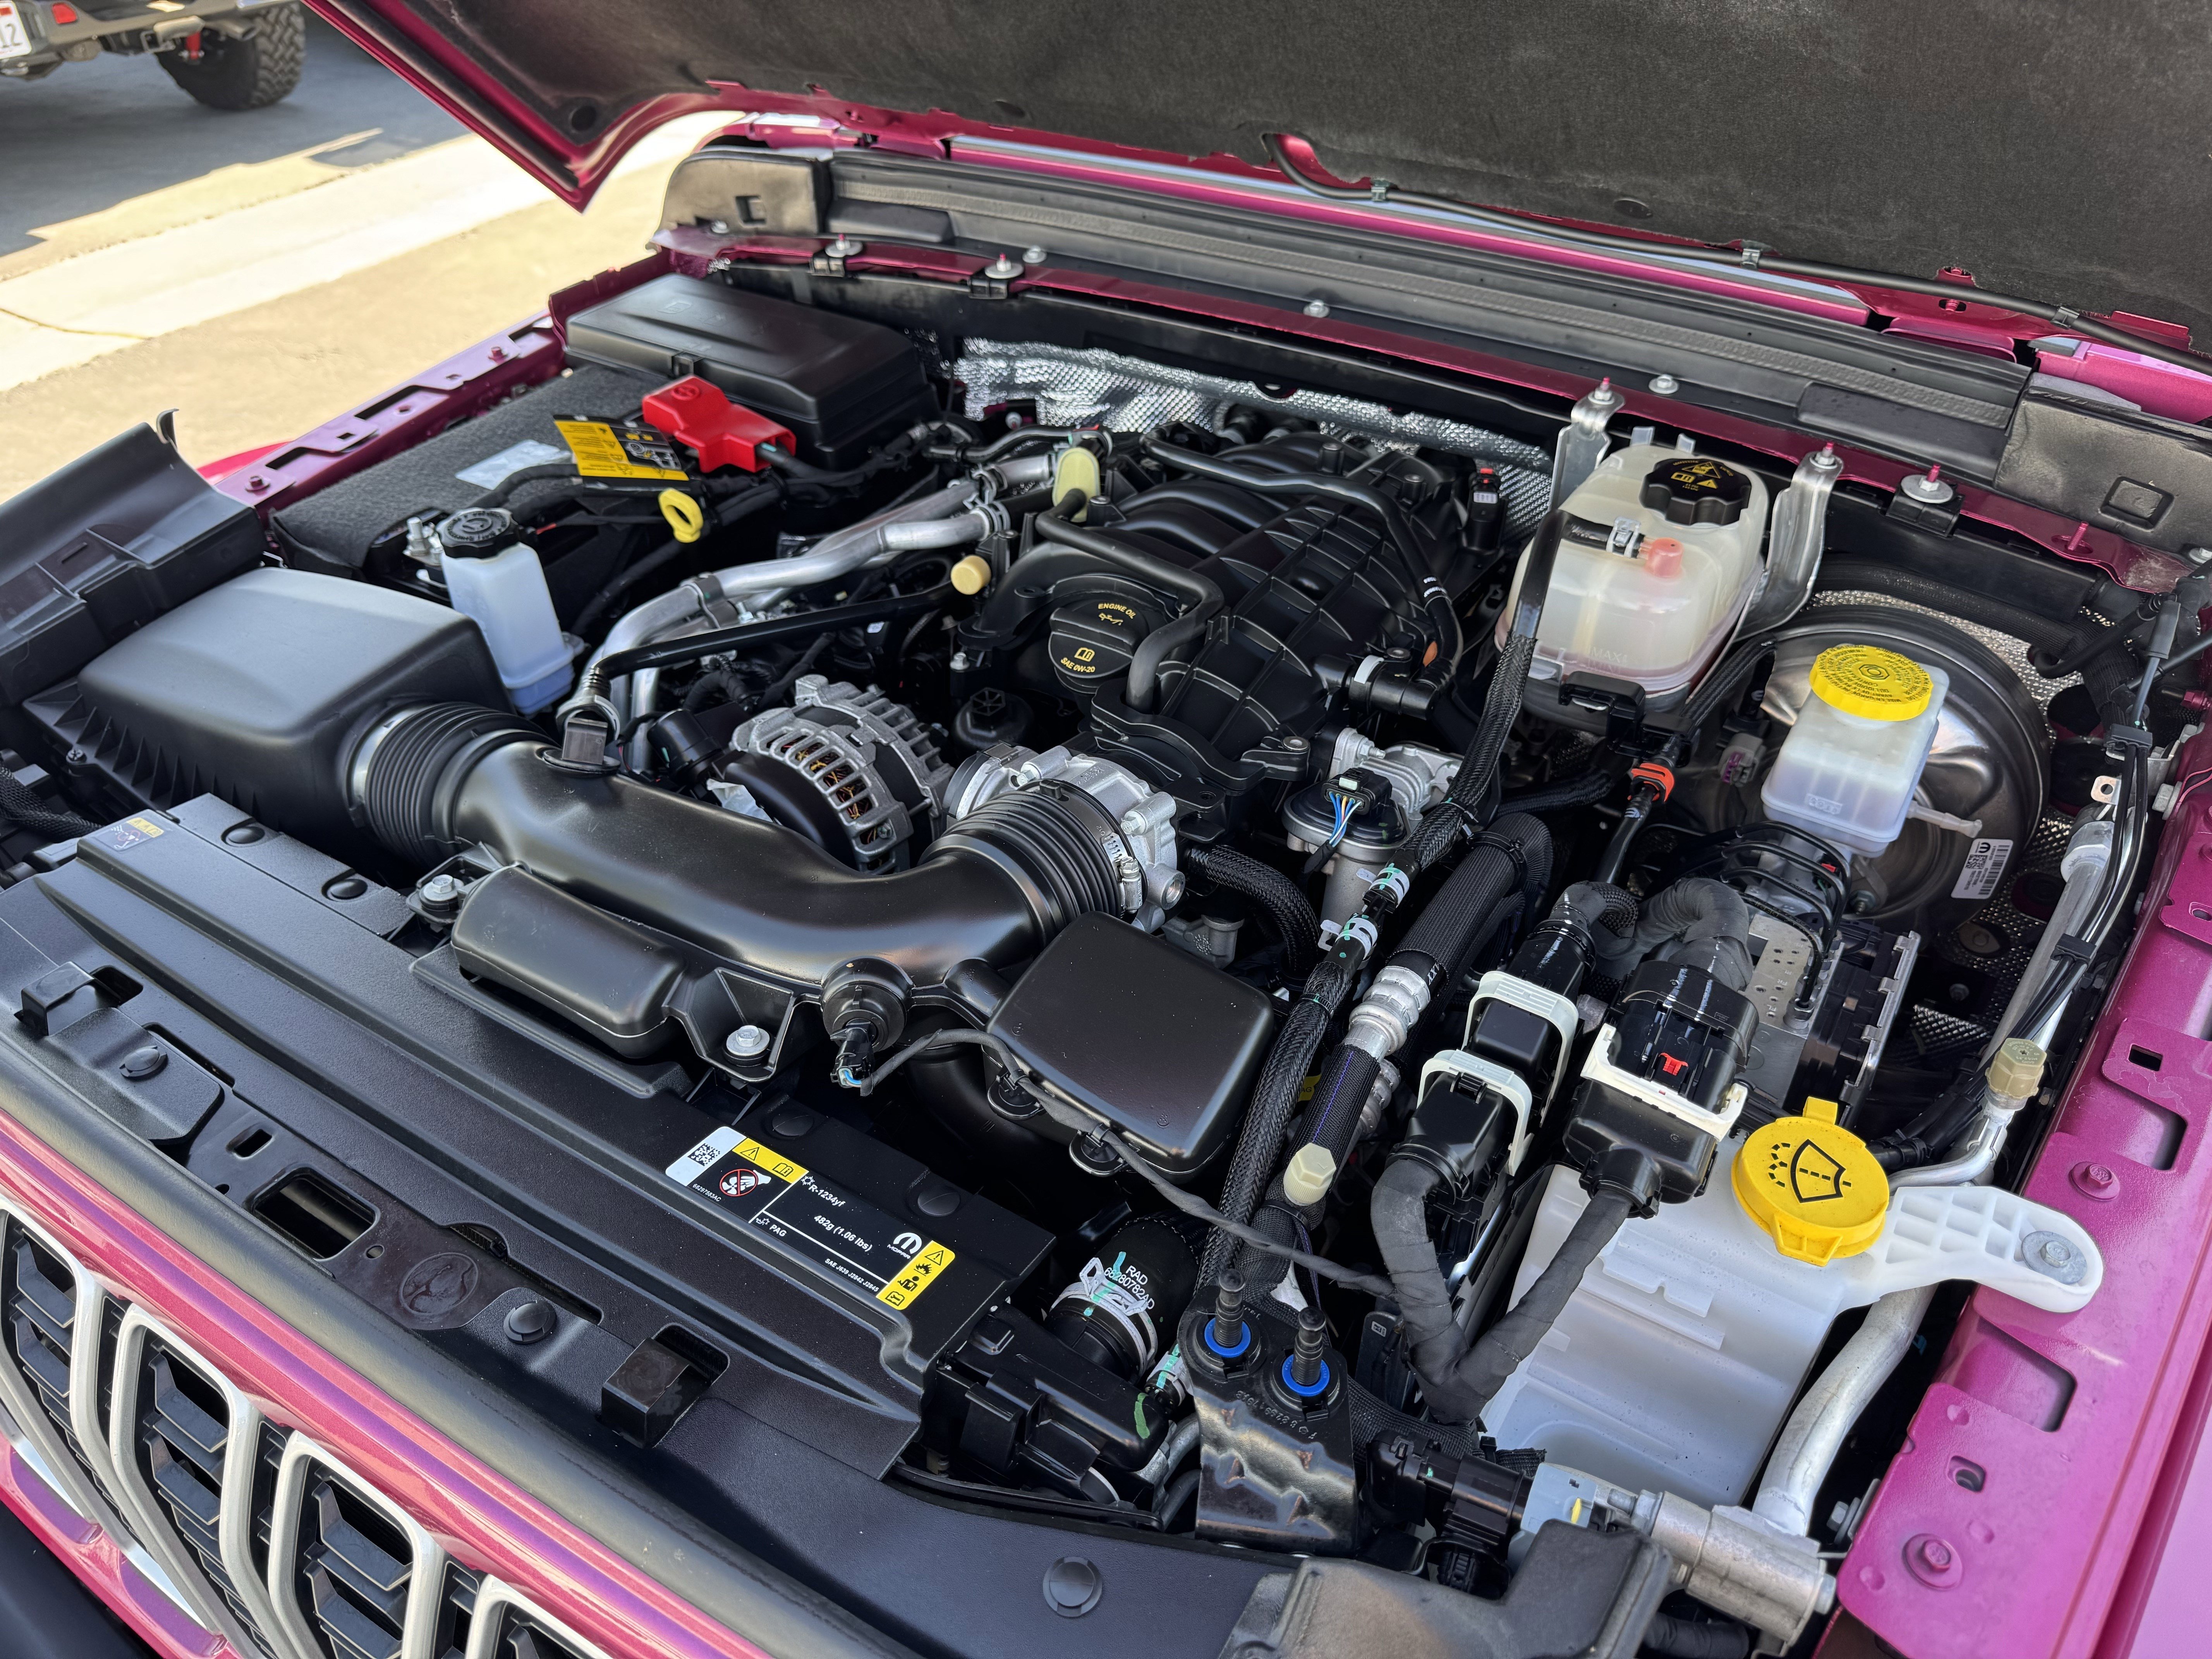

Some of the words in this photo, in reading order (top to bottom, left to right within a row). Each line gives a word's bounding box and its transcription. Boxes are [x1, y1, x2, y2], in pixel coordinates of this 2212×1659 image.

[1098, 603, 1127, 612] ENGINE
[1125, 609, 1136, 619] OIL
[1061, 657, 1075, 669] SAE
[1073, 664, 1096, 673] 0W-20
[808, 1184, 846, 1207] R-1234yf
[769, 1224, 787, 1237] PAG
[814, 1215, 835, 1231] 482g
[833, 1226, 856, 1241] (1.06
[854, 1238, 872, 1252] lbs)
[887, 1244, 911, 1259] MOPAR
[824, 1258, 837, 1268] SAE
[836, 1265, 849, 1274] J639
[1125, 1265, 1148, 1285] RAD
